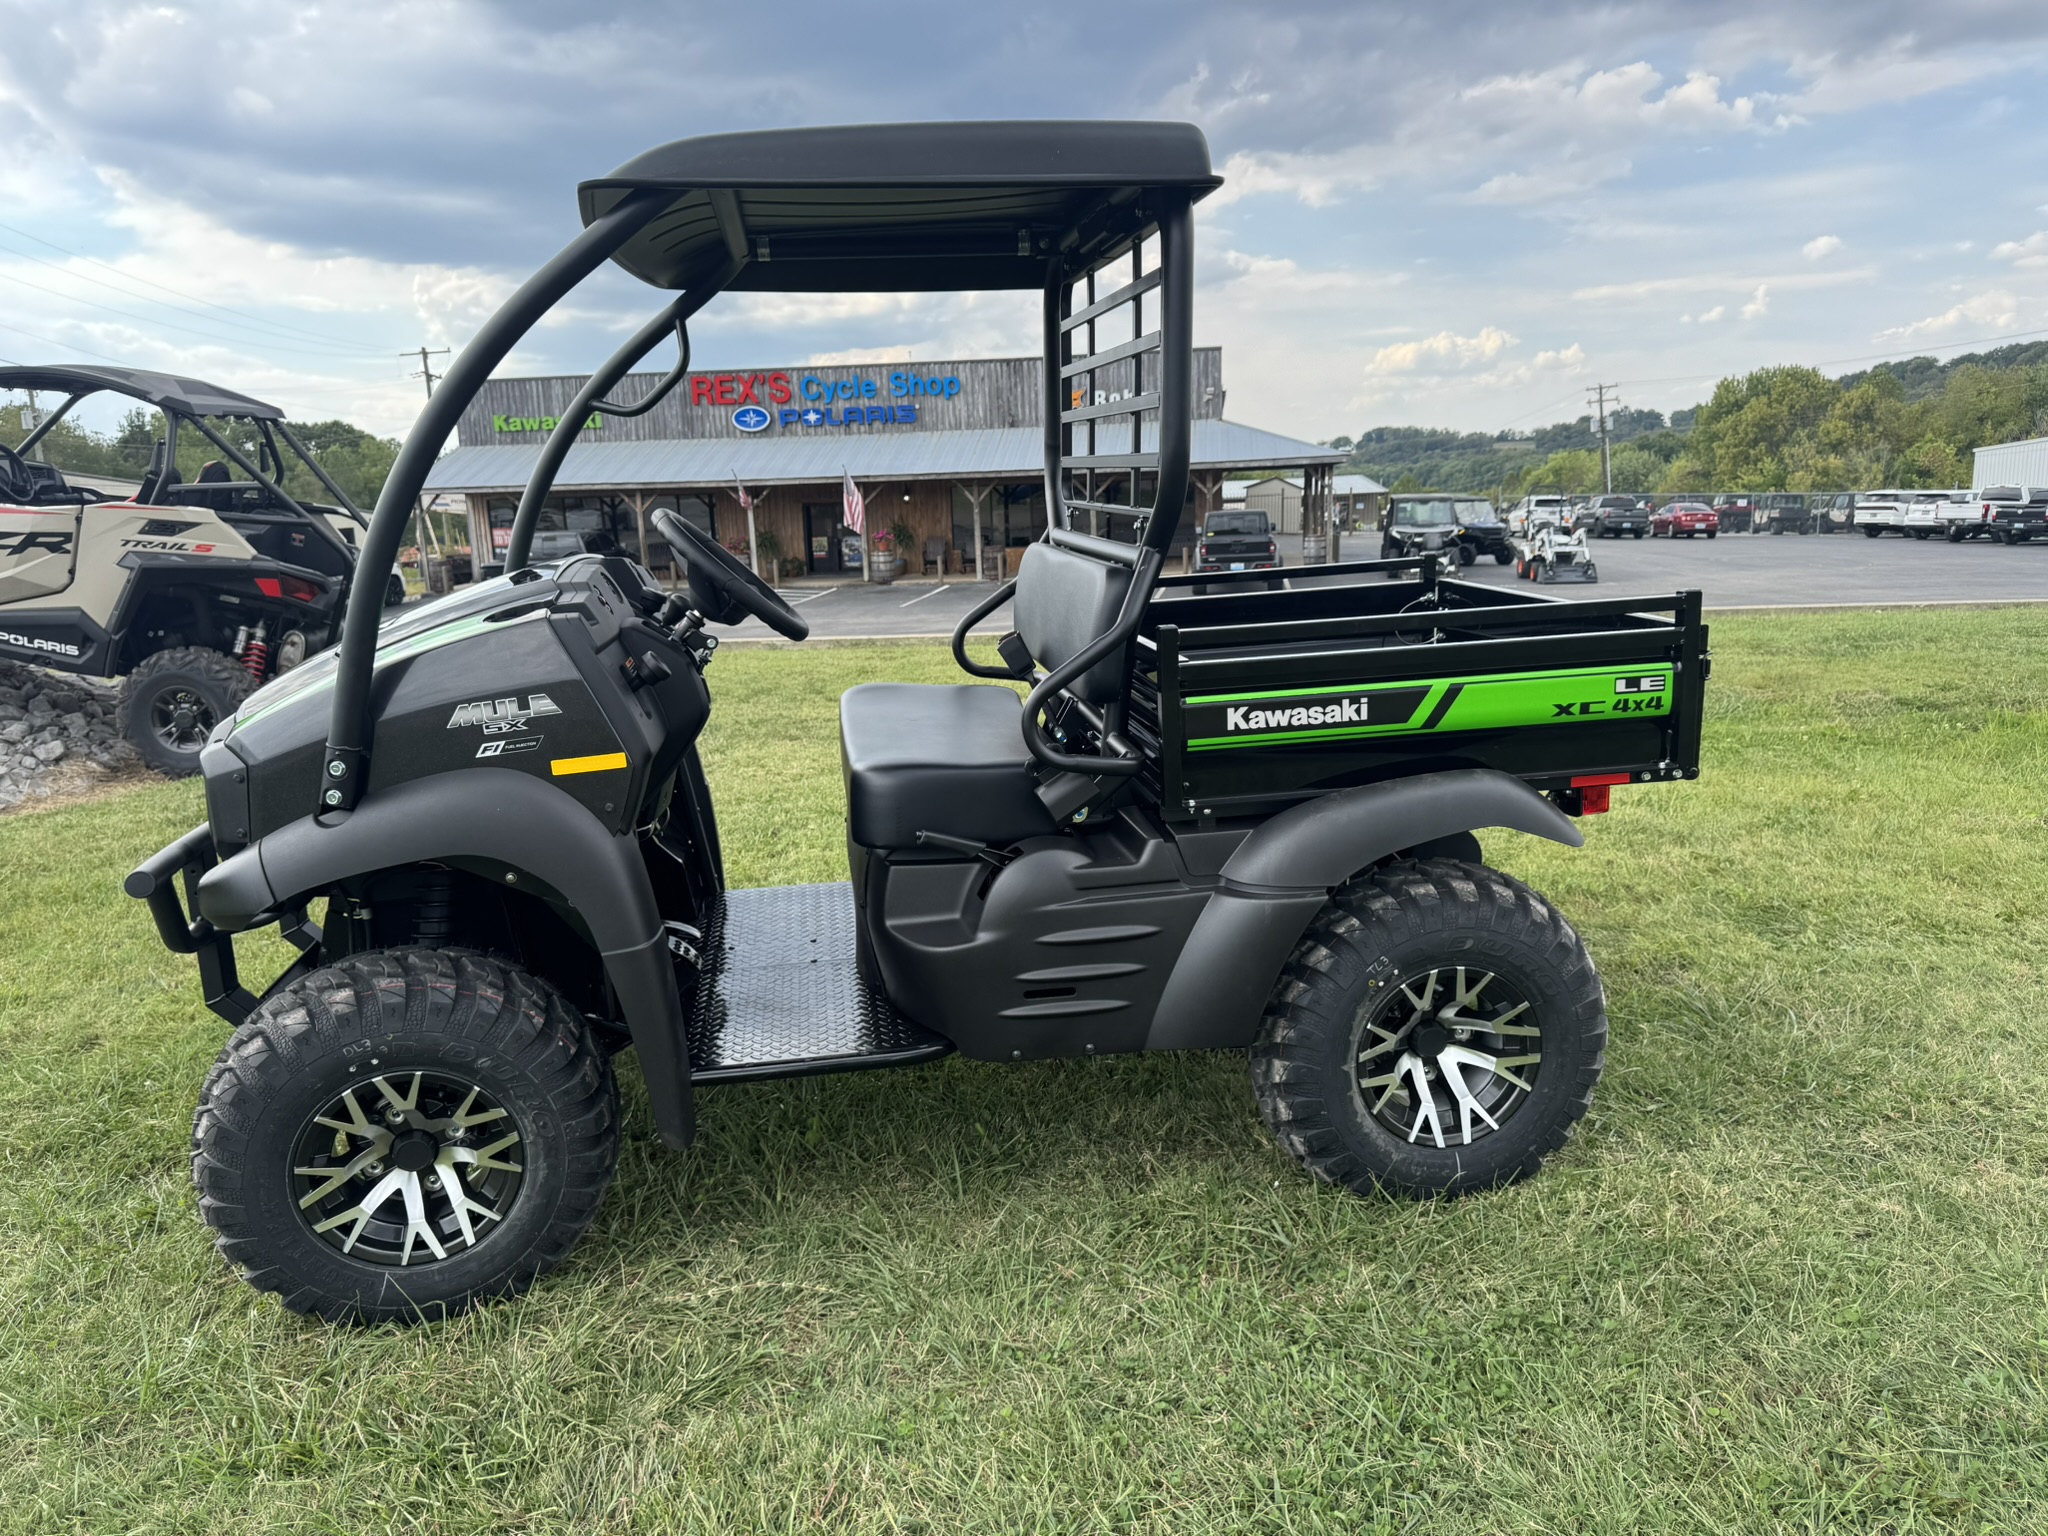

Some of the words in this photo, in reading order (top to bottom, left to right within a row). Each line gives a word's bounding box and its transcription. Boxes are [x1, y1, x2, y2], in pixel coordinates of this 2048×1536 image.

[690, 371, 792, 405] REX'S
[801, 374, 877, 404] Cycle
[889, 371, 961, 399] Shop
[779, 404, 917, 427] POLARIS
[120, 539, 189, 552] TRAIL
[191, 543, 216, 553] S
[1615, 676, 1665, 693] LE
[447, 694, 562, 728] MULE
[1227, 697, 1368, 730] Kawasaki
[1551, 700, 1606, 717] XC
[1612, 696, 1664, 712] 4x4
[483, 718, 529, 735] SX
